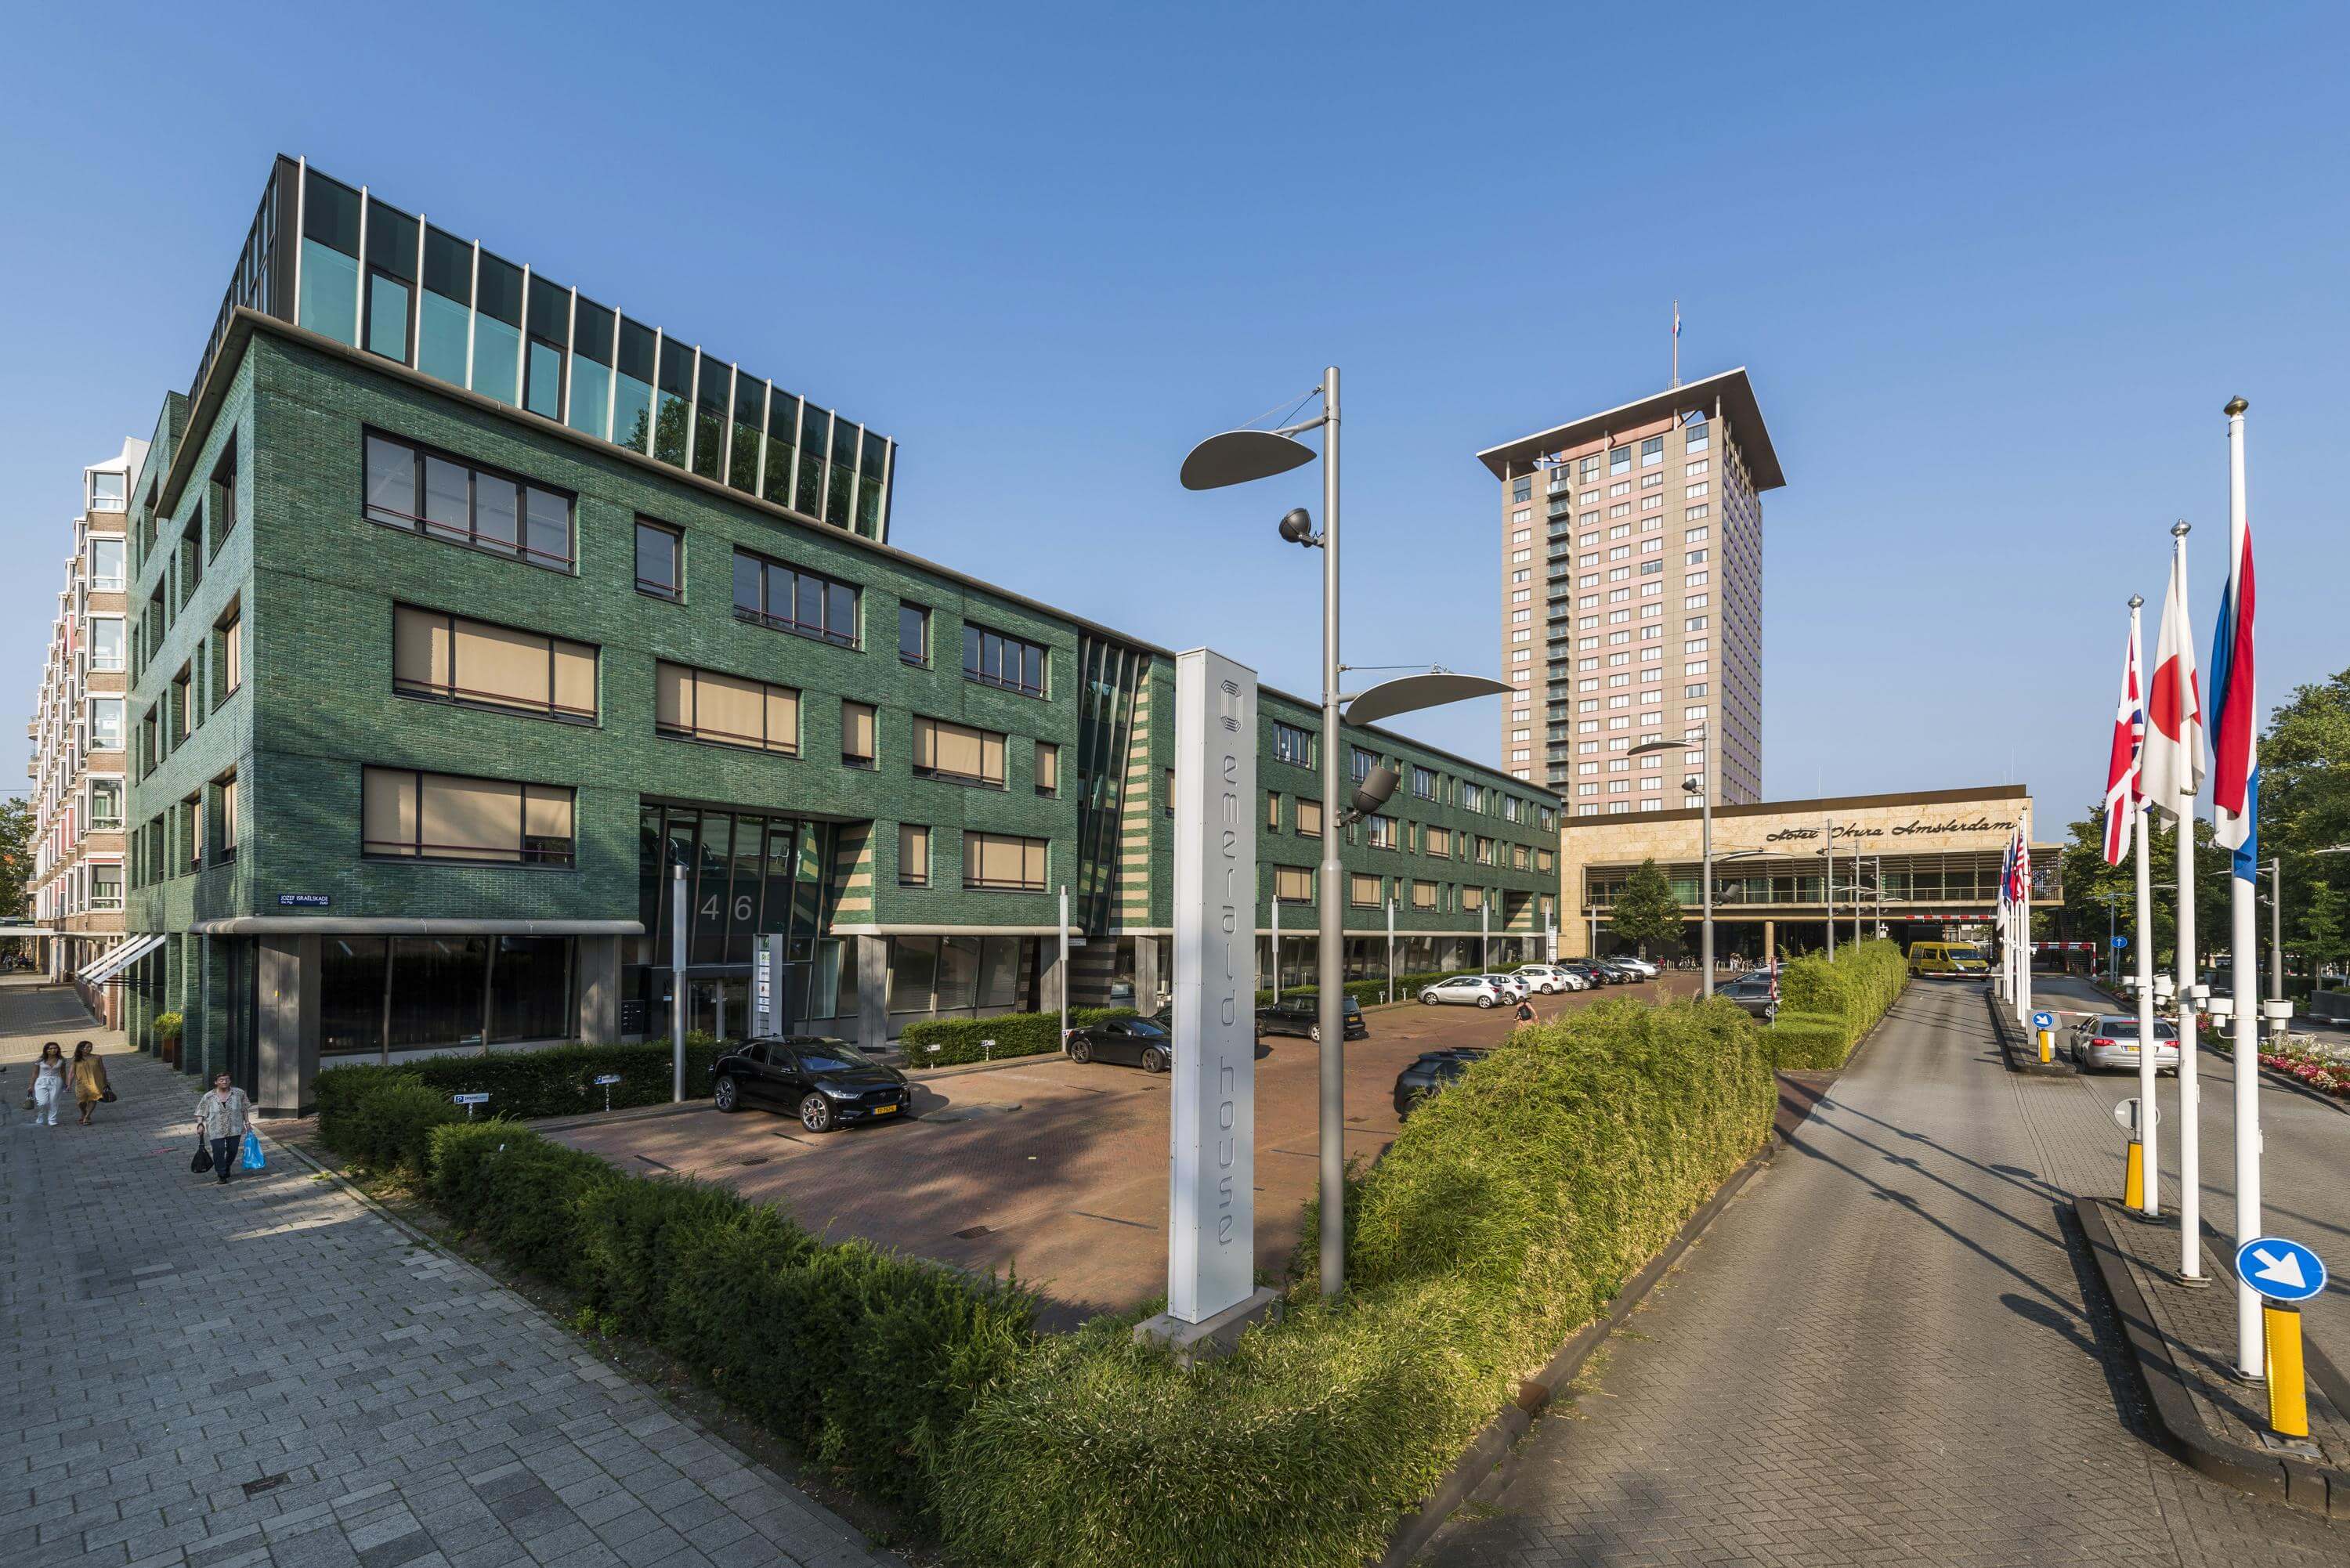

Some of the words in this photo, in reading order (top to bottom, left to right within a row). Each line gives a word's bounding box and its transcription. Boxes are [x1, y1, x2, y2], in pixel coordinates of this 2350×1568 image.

[1221, 754, 1239, 1027] emerald
[1766, 828, 1820, 842] Hotel
[1830, 822, 1884, 838] Okura
[1892, 817, 2015, 836] Amsterdam
[1219, 1056, 1235, 1246] house
